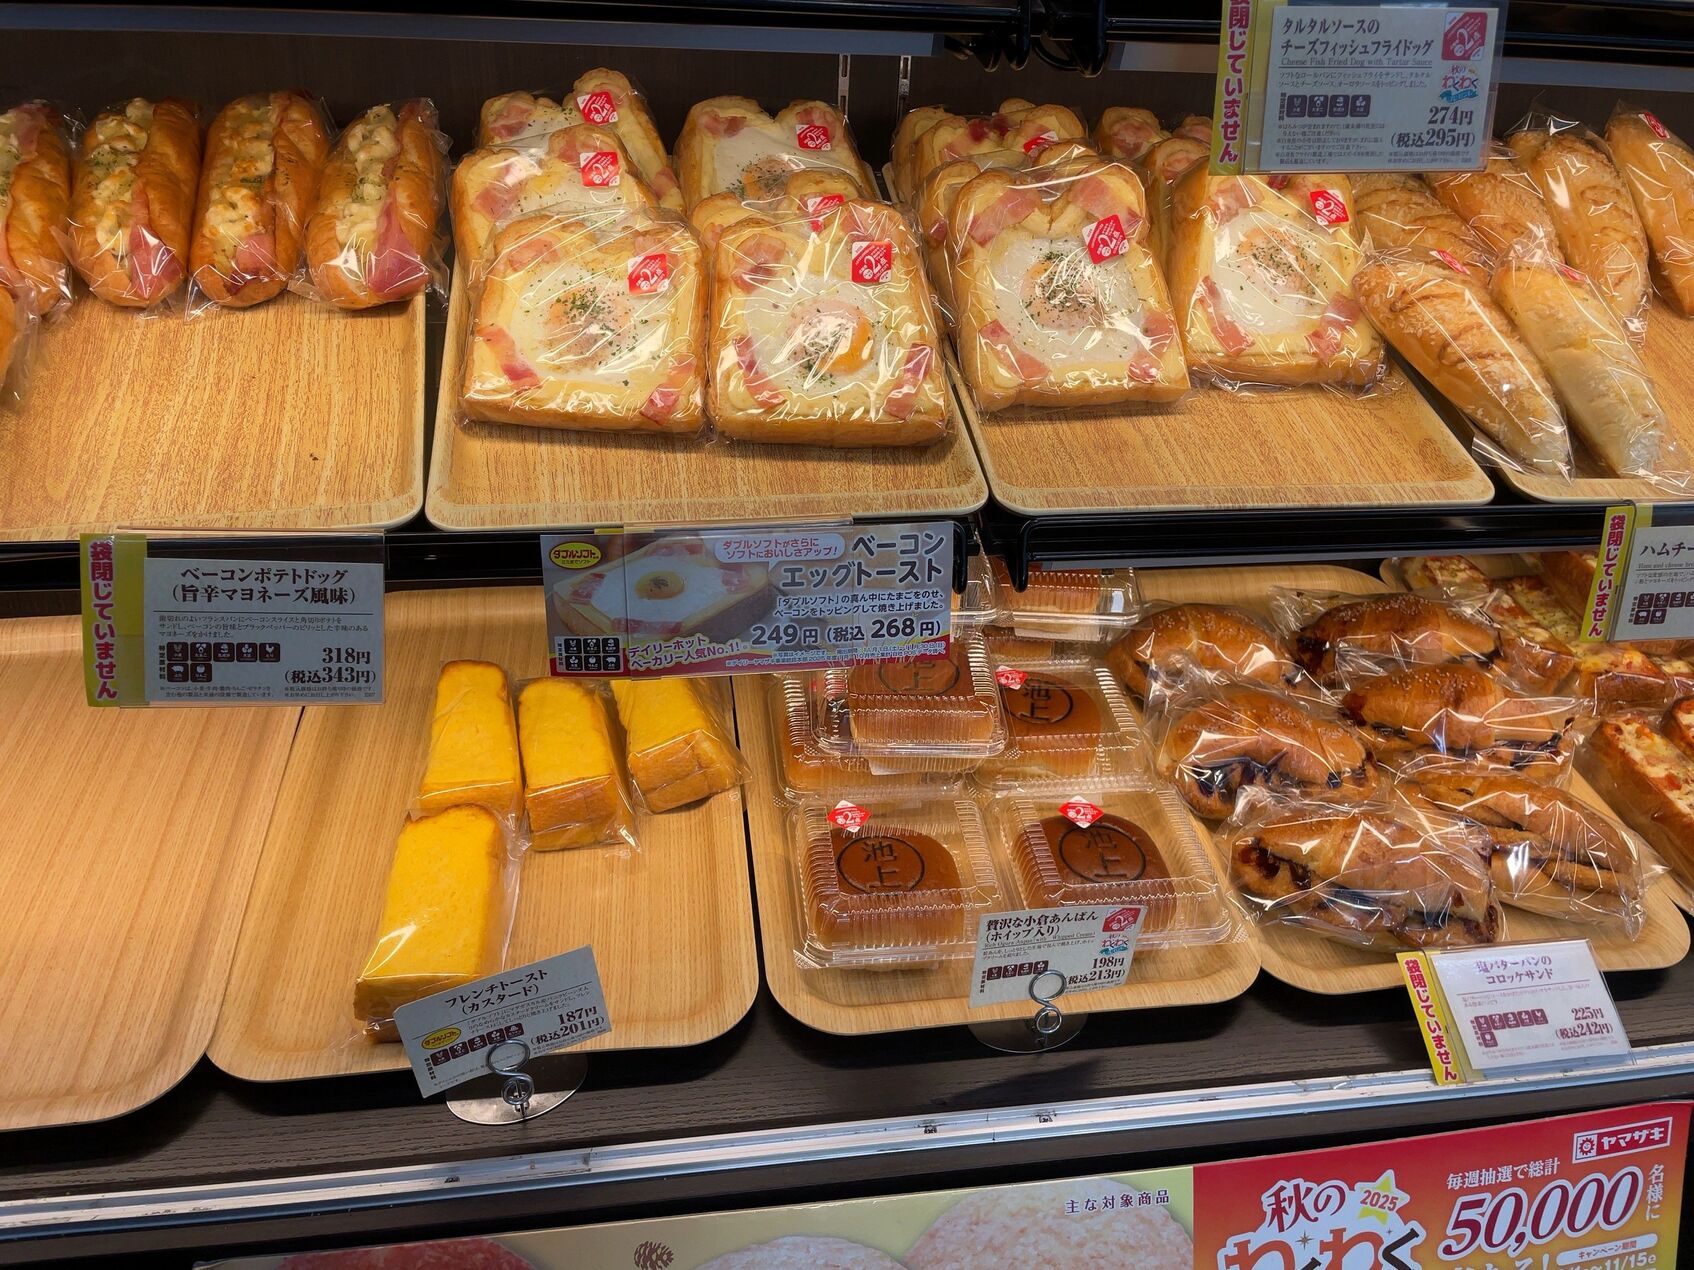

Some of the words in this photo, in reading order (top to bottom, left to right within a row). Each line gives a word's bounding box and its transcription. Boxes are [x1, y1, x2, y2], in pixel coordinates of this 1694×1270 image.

[1283, 18, 1380, 35] タルタルソースの
[1281, 38, 1434, 57] チーズフィッシュフライドッグ
[1281, 57, 1307, 66] Cheese
[1310, 57, 1325, 66] Fish
[1327, 57, 1348, 66] Fried
[1350, 57, 1365, 67] Dog
[1367, 57, 1383, 66] with
[1386, 57, 1410, 66] Tartar
[1412, 57, 1433, 66] Sauce
[1428, 106, 1474, 126] 274円
[1390, 128, 1476, 150] （税込295円）
[723, 537, 820, 551] ダブルソフトがさらに
[727, 546, 839, 562] ソフトにおいしさアップ！
[852, 532, 944, 557] ベーコン
[181, 567, 348, 585] ベーコンポテトドッグ
[782, 559, 942, 588] エッグトースト
[1588, 514, 1626, 638] 袋閉じていません
[172, 584, 356, 605] （旨辛マヨネーズ風味）
[778, 590, 944, 607] 「ダブルソフト」の真ん中にたまごをのせ、
[775, 601, 944, 618] ベーコンをトッピングして焼き上げました。
[89, 541, 118, 699] 袋閉じていません
[322, 647, 371, 665] 318円
[629, 637, 706, 657] デイリーホット
[284, 666, 376, 684] （税込343円）
[862, 841, 902, 889] 池上
[986, 925, 1061, 943] （ホイップ入り）
[1092, 957, 1126, 972] 198円
[1476, 955, 1552, 974] 塩バターパンの
[1486, 967, 1553, 985] コロッケサンド
[445, 969, 549, 1009] フレンチトースト
[461, 983, 540, 1017] （カスタード）
[557, 1006, 599, 1026] 187円
[1405, 959, 1458, 1082] 袋閉じていません
[1571, 1007, 1605, 1022] 225円
[529, 1017, 605, 1047] （税込201円）
[1555, 1022, 1614, 1041] （税込242円）
[1600, 1127, 1665, 1152] ヤマザキ
[1447, 1157, 1560, 1190] 毎週抽選で総計
[1065, 1189, 1170, 1214] 主な対象商品
[1360, 1189, 1399, 1213] 2025
[1646, 1164, 1664, 1222] 名様に
[1267, 1183, 1346, 1233] 秋の
[1442, 1171, 1638, 1256] 50,000
[1579, 1240, 1637, 1260] キャンペーン期間
